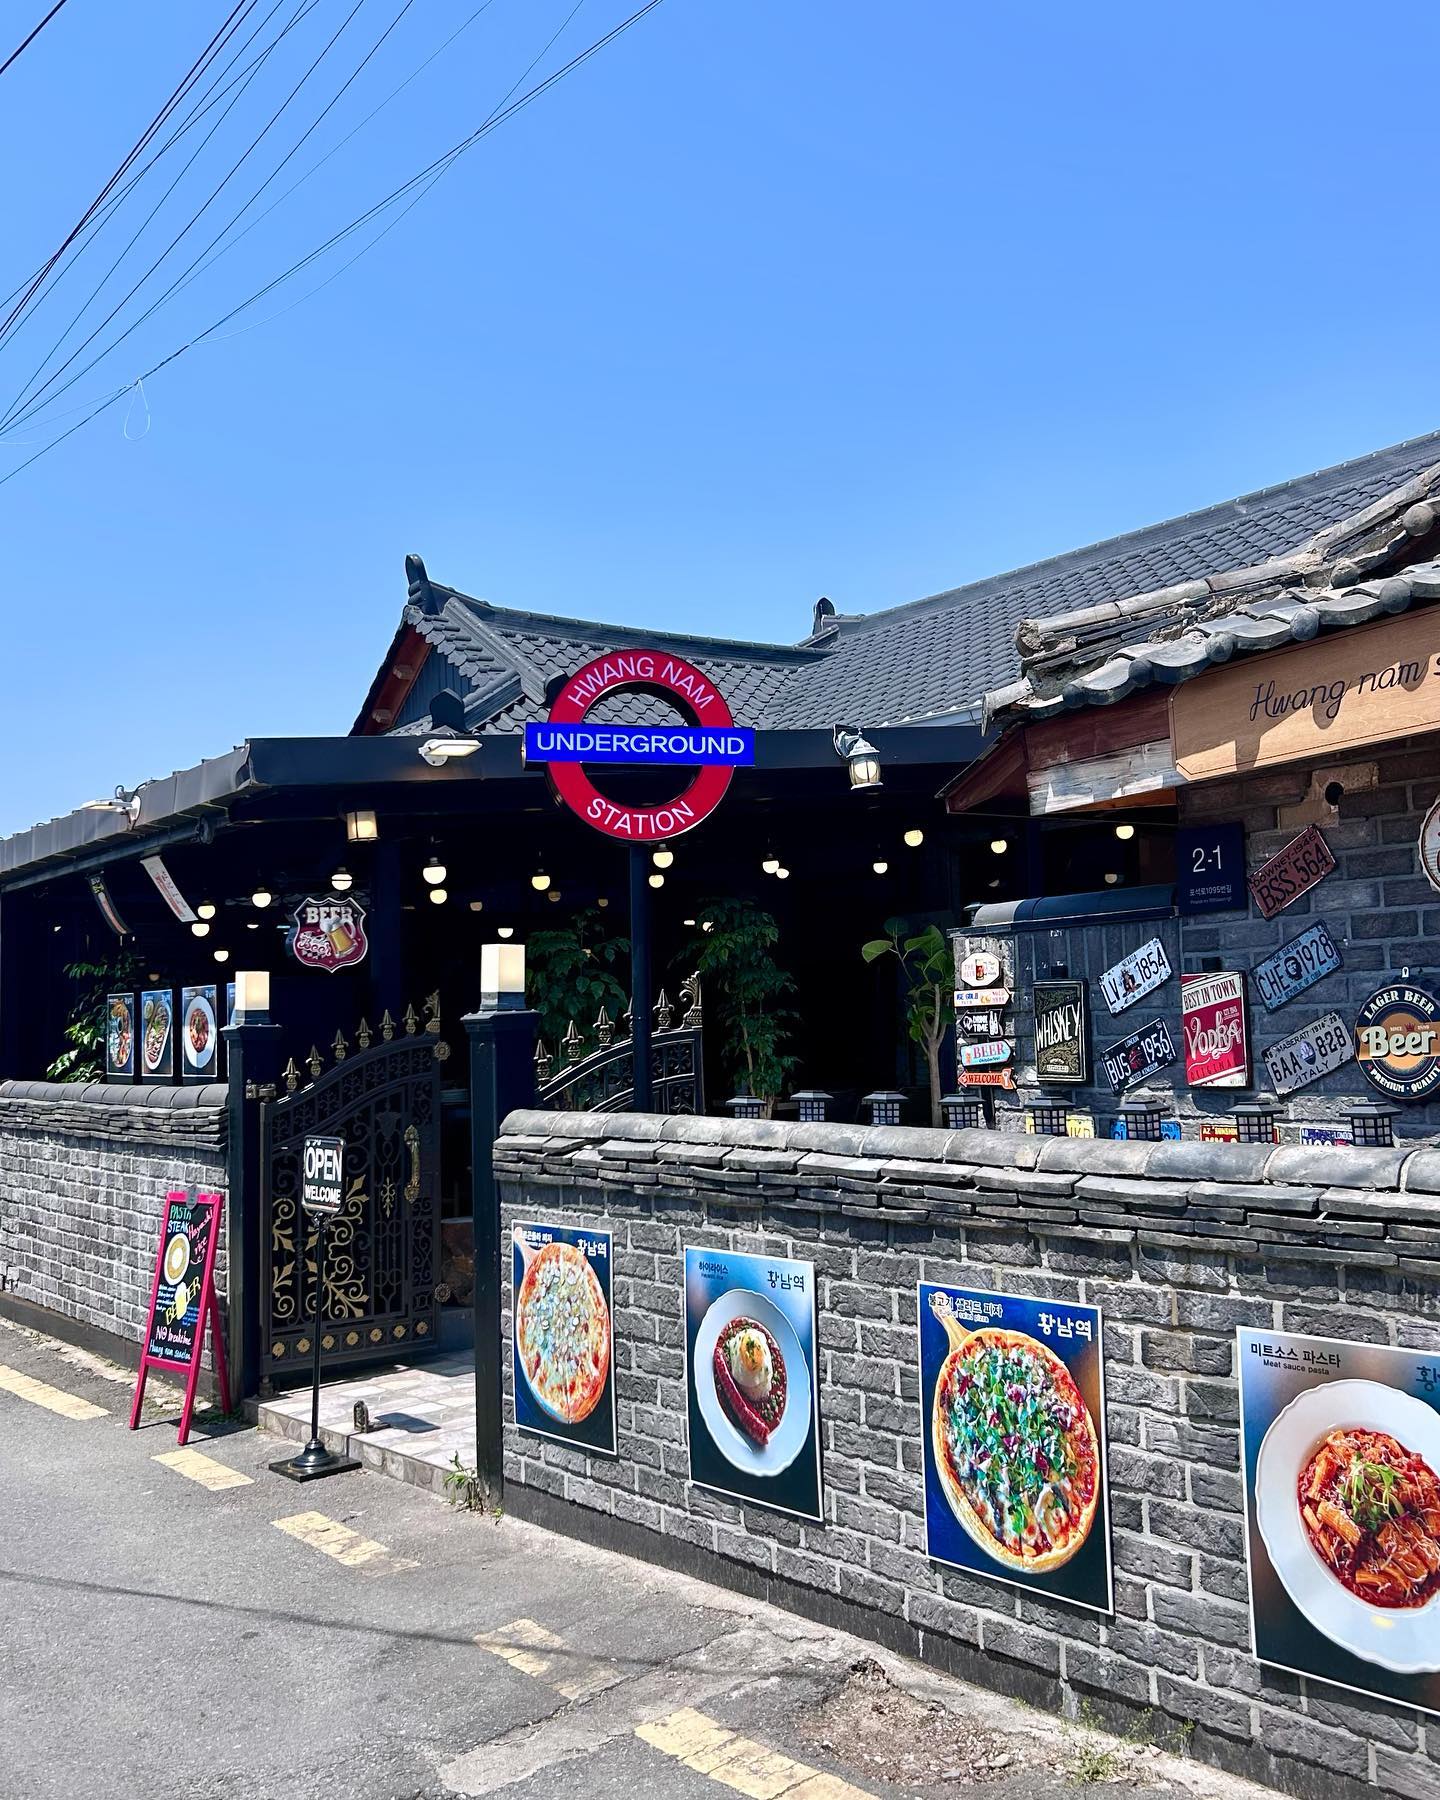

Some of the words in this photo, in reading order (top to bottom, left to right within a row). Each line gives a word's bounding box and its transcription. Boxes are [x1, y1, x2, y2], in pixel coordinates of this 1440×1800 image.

[567, 656, 655, 708] HWANG
[660, 660, 715, 709] NAM
[1249, 680, 1351, 722] Hwang
[1358, 661, 1429, 695] nam
[537, 732, 745, 755] UNDERGROUND
[586, 798, 695, 835] STATION
[1192, 845, 1222, 872] 2-1
[305, 906, 354, 924] BEER
[1103, 977, 1120, 1006] LV
[1134, 946, 1167, 984] 1854
[1257, 963, 1291, 1001] CHE
[1296, 933, 1335, 974] 1928
[1184, 989, 1201, 1010] BEST
[1200, 985, 1211, 1004] IN
[1210, 978, 1238, 1001] TOWN
[1363, 989, 1400, 1020] LAGER
[1403, 990, 1435, 1016] BEER
[973, 1024, 988, 1032] TIME
[1035, 1001, 1080, 1052] WHISKEY
[973, 1043, 1004, 1059] BEER
[1270, 1051, 1303, 1083] 6AA
[1315, 1025, 1347, 1057] 828
[1360, 1025, 1437, 1058] Beer
[1106, 1052, 1131, 1085] BUS
[1140, 1029, 1170, 1064] 1956
[966, 1074, 1001, 1084] WELCOME
[1298, 1059, 1330, 1083] ITALY
[1370, 1068, 1405, 1093] PREMIUM
[305, 1146, 343, 1182] OPEN
[305, 1184, 342, 1204] WELCOME
[167, 1220, 190, 1233] STEAK
[577, 1238, 608, 1259] 황남역
[767, 1270, 805, 1293] 황남역
[983, 1301, 1003, 1318] 피자
[1037, 1312, 1093, 1343] 황남역
[1250, 1342, 1299, 1361] 미트소스
[1302, 1349, 1342, 1369] 파스타
[1262, 1357, 1282, 1369] Meat
[1283, 1362, 1306, 1373] sauce
[1308, 1366, 1330, 1377] pasta
